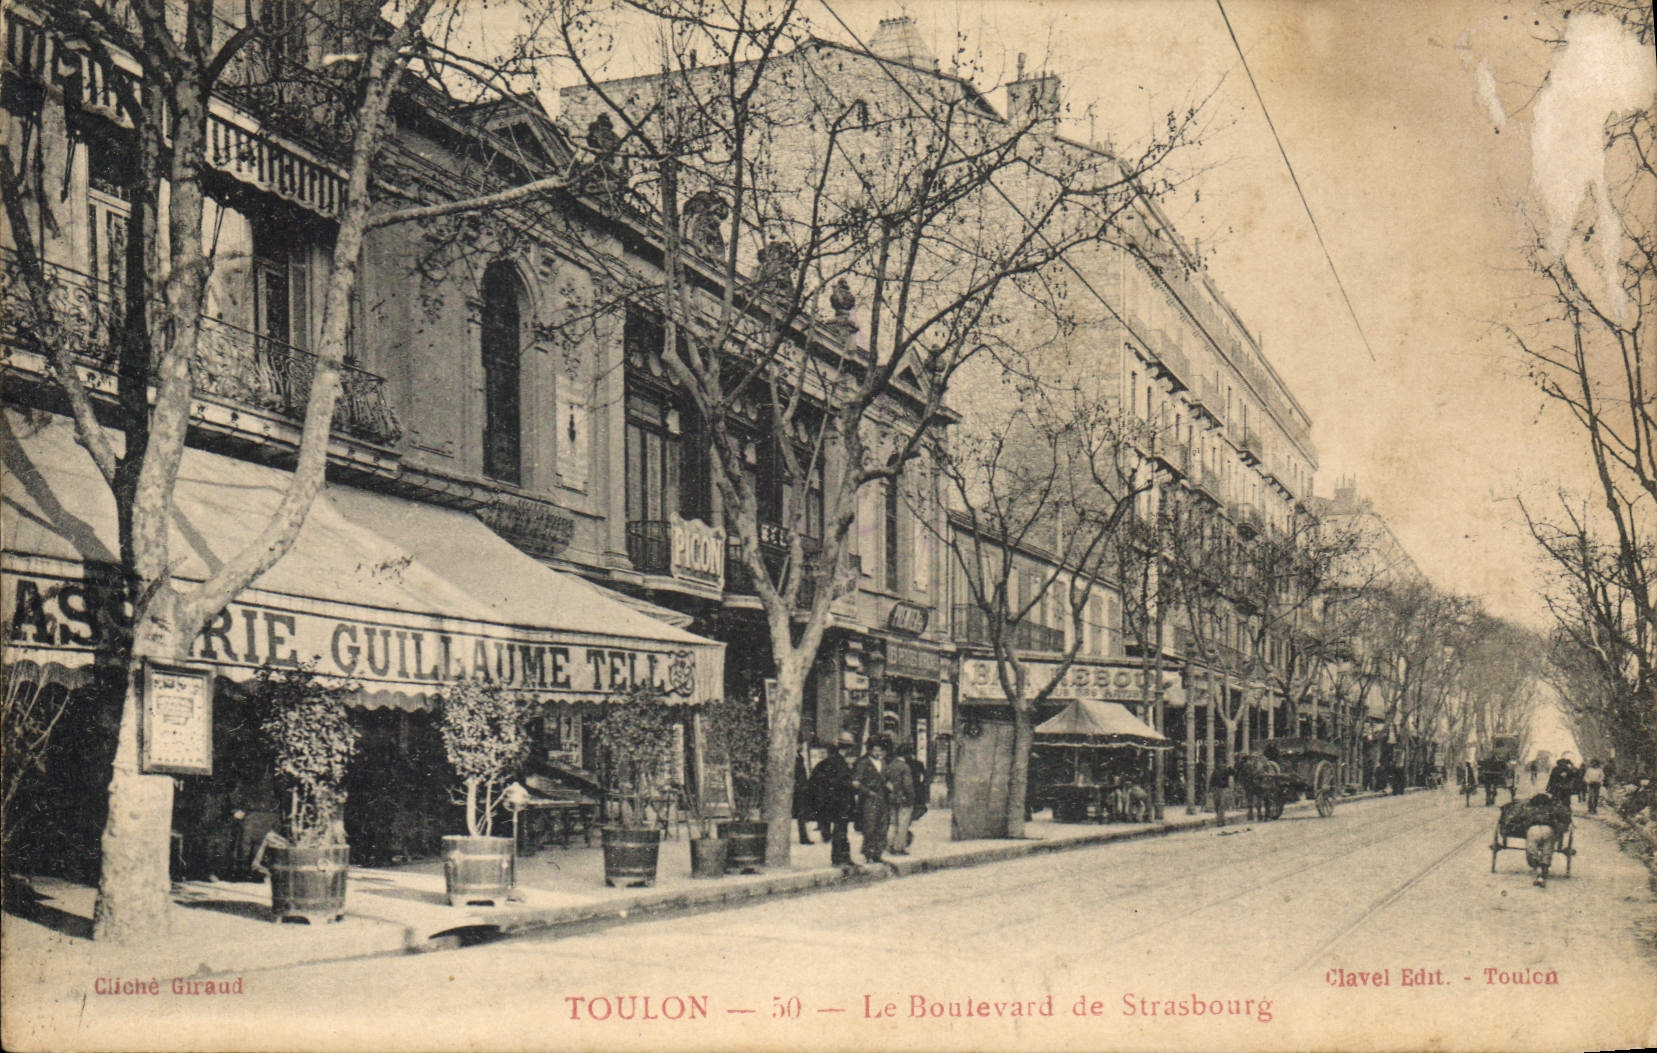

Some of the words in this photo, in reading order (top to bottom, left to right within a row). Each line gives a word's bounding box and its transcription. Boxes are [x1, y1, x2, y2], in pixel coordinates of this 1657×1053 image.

[672, 527, 722, 577] PICON
[9, 578, 299, 669] ASSRIE
[330, 622, 572, 690] GUILLAUME
[586, 648, 665, 693] TELL
